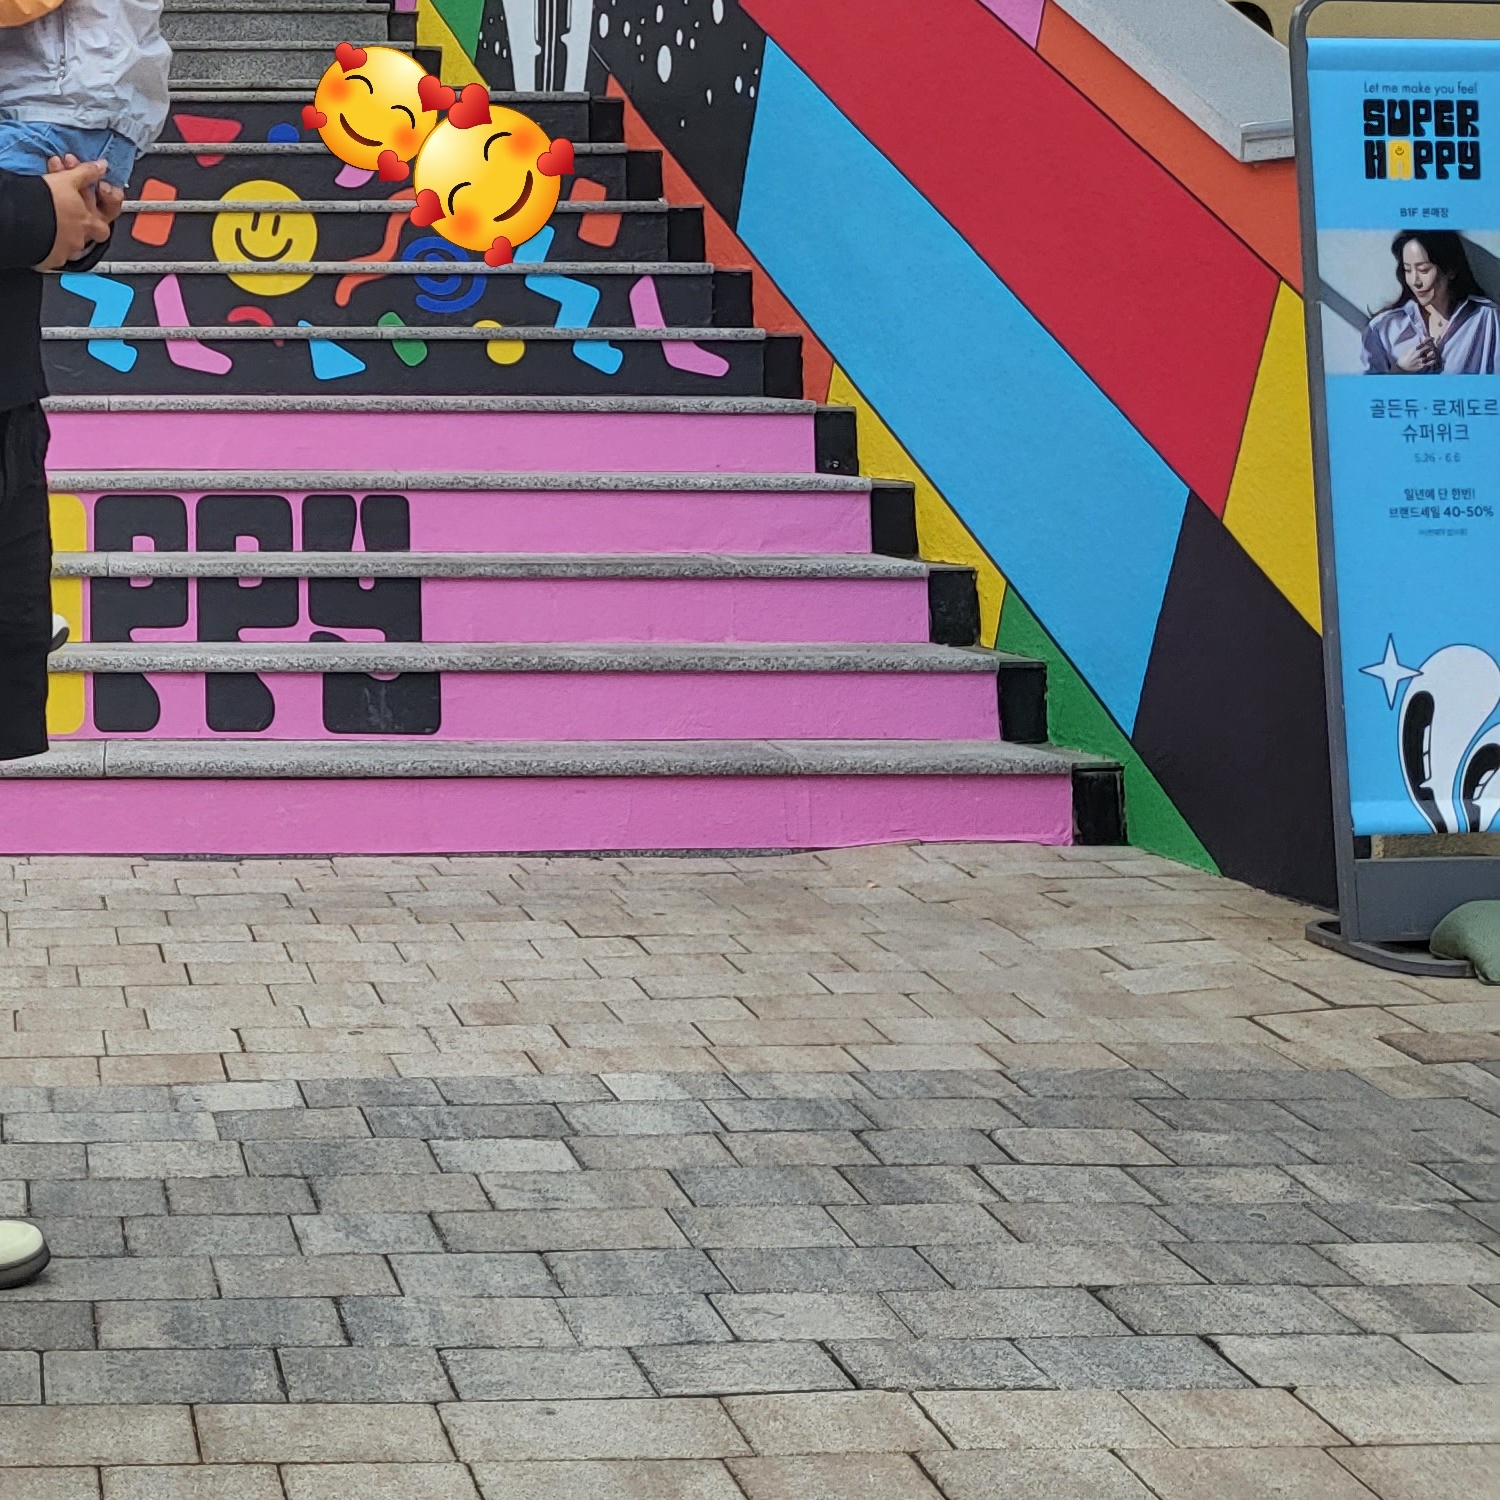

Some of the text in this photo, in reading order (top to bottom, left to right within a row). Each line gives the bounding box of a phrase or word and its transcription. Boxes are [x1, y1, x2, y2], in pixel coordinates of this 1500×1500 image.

[1363, 81, 1477, 97] Let me make you feel
[1363, 99, 1479, 137] SUPER
[1364, 139, 1481, 180] HAPPY
[1402, 423, 1470, 443] 슈퍼위크
[1443, 505, 1494, 518] 40-50%
